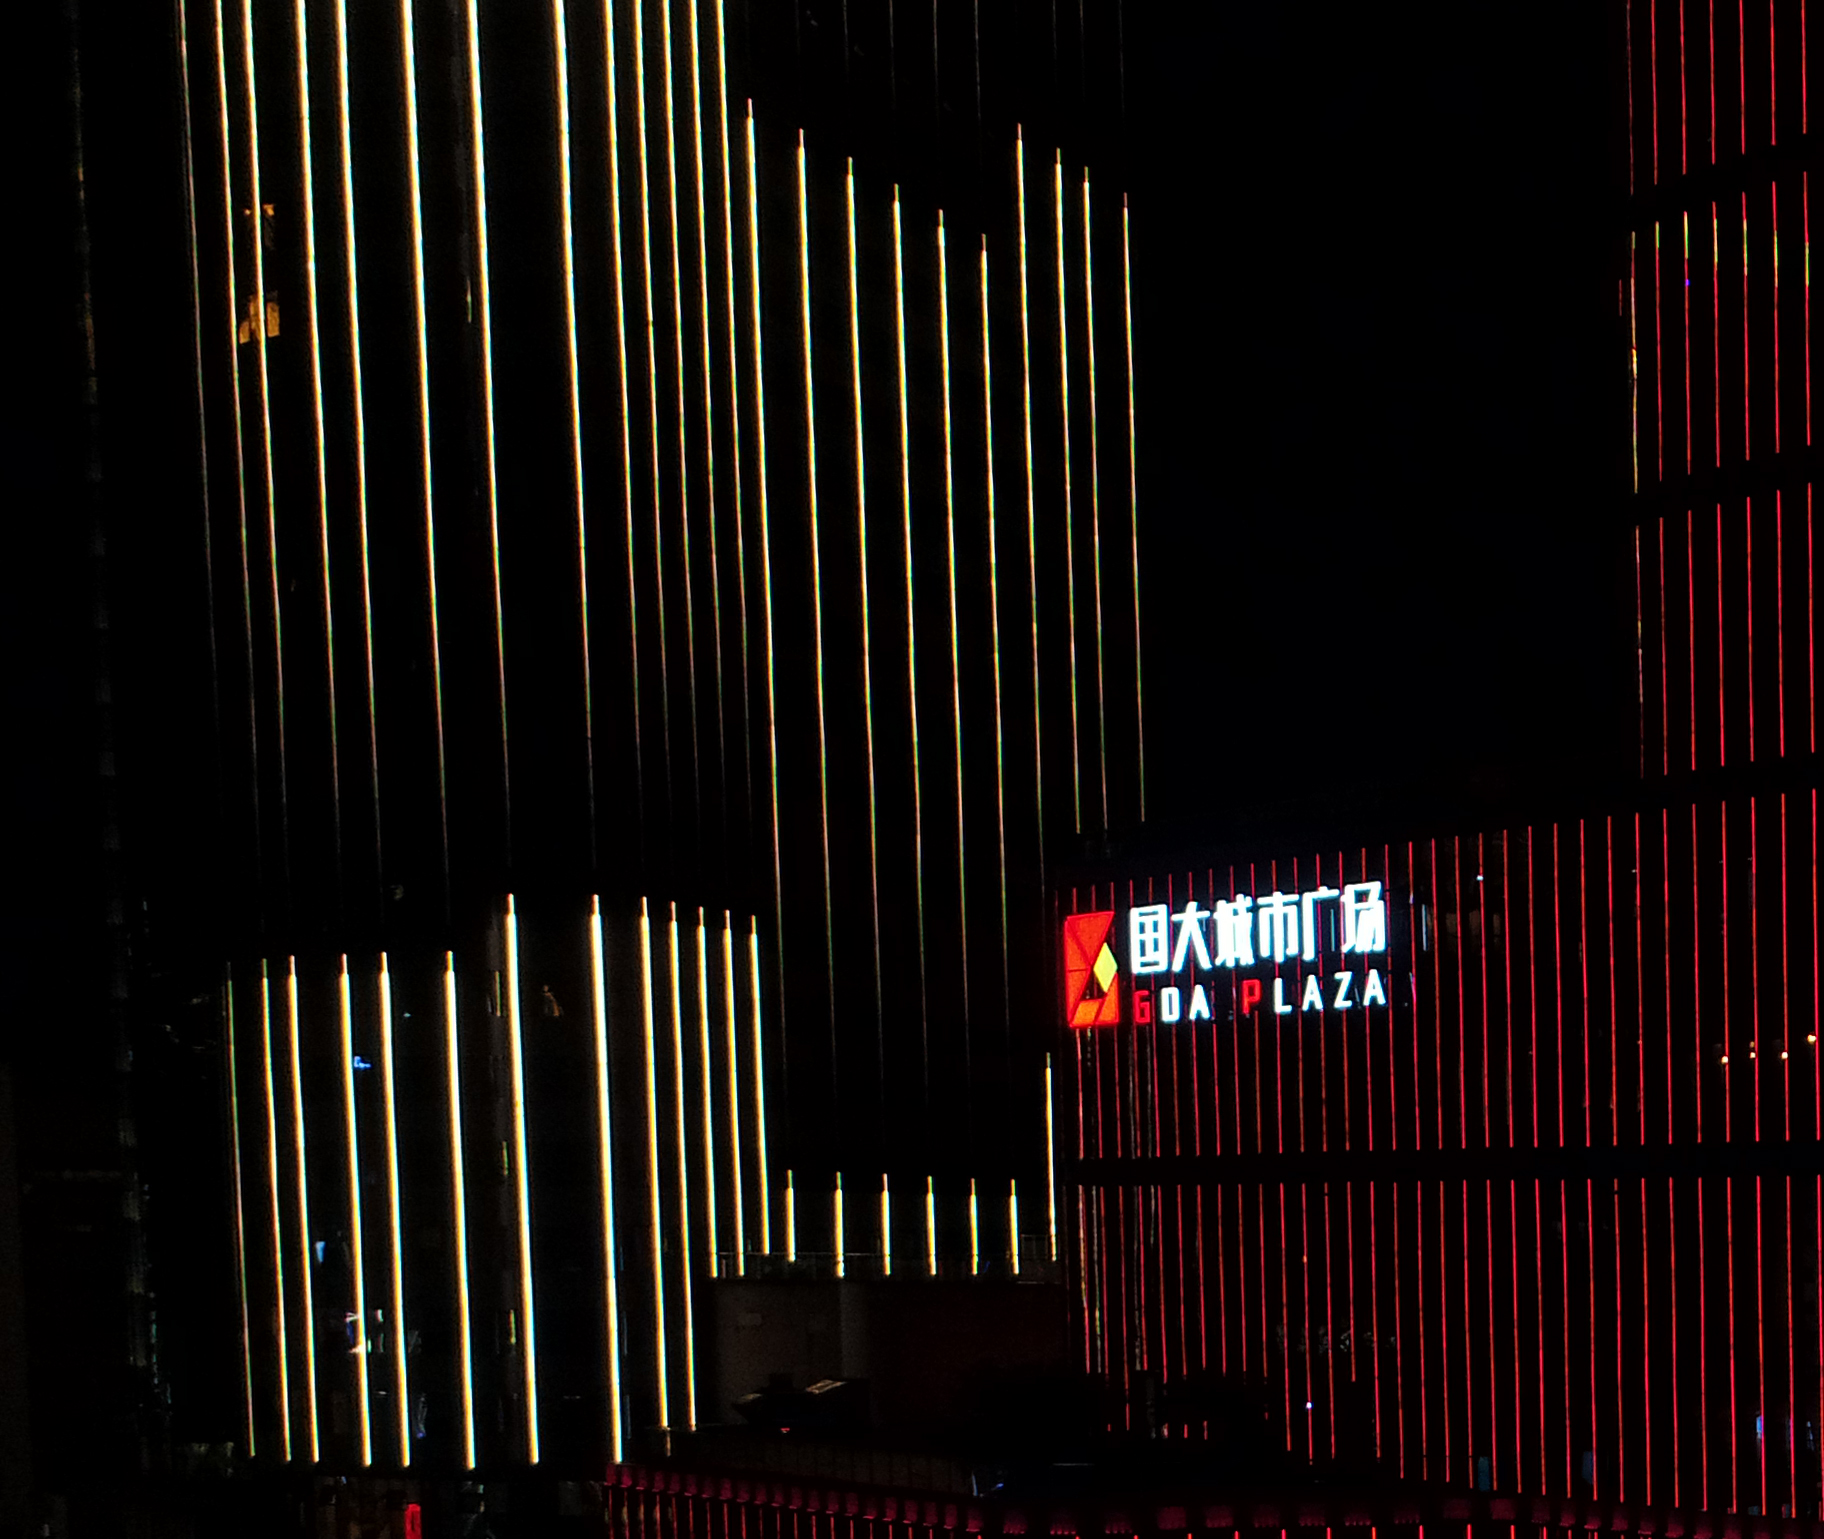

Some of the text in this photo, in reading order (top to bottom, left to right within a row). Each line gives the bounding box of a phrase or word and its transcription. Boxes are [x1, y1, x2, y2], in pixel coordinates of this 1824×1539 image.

[1130, 881, 1386, 974] 国大城市广场
[1242, 969, 1387, 1014] PLAZA
